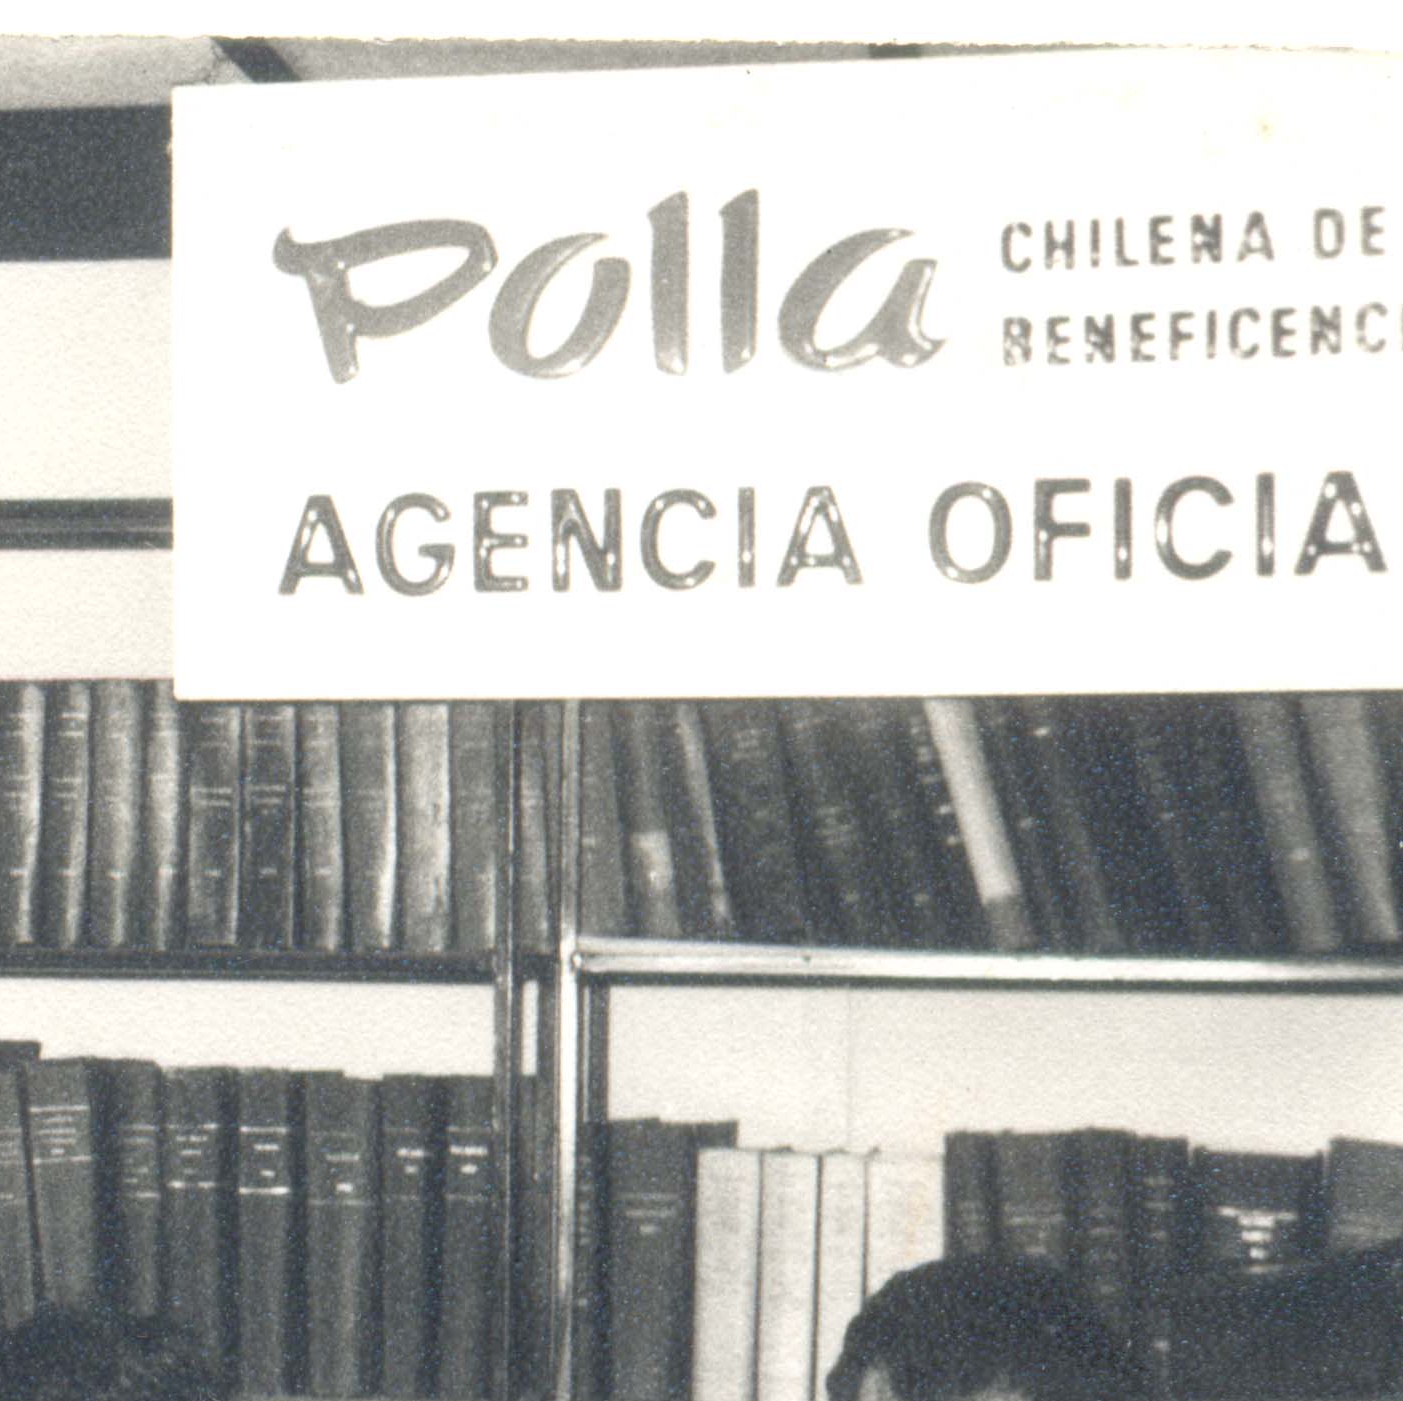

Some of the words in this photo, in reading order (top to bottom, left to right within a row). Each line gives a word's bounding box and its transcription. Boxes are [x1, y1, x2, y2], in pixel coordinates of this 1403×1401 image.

[272, 188, 948, 385] Polla
[1000, 209, 1274, 274] CHILENA
[1313, 205, 1385, 260] DE
[1002, 301, 1403, 367] BENEFICENC
[278, 485, 864, 598] AGENCIA
[928, 469, 1388, 585] OFICIA
